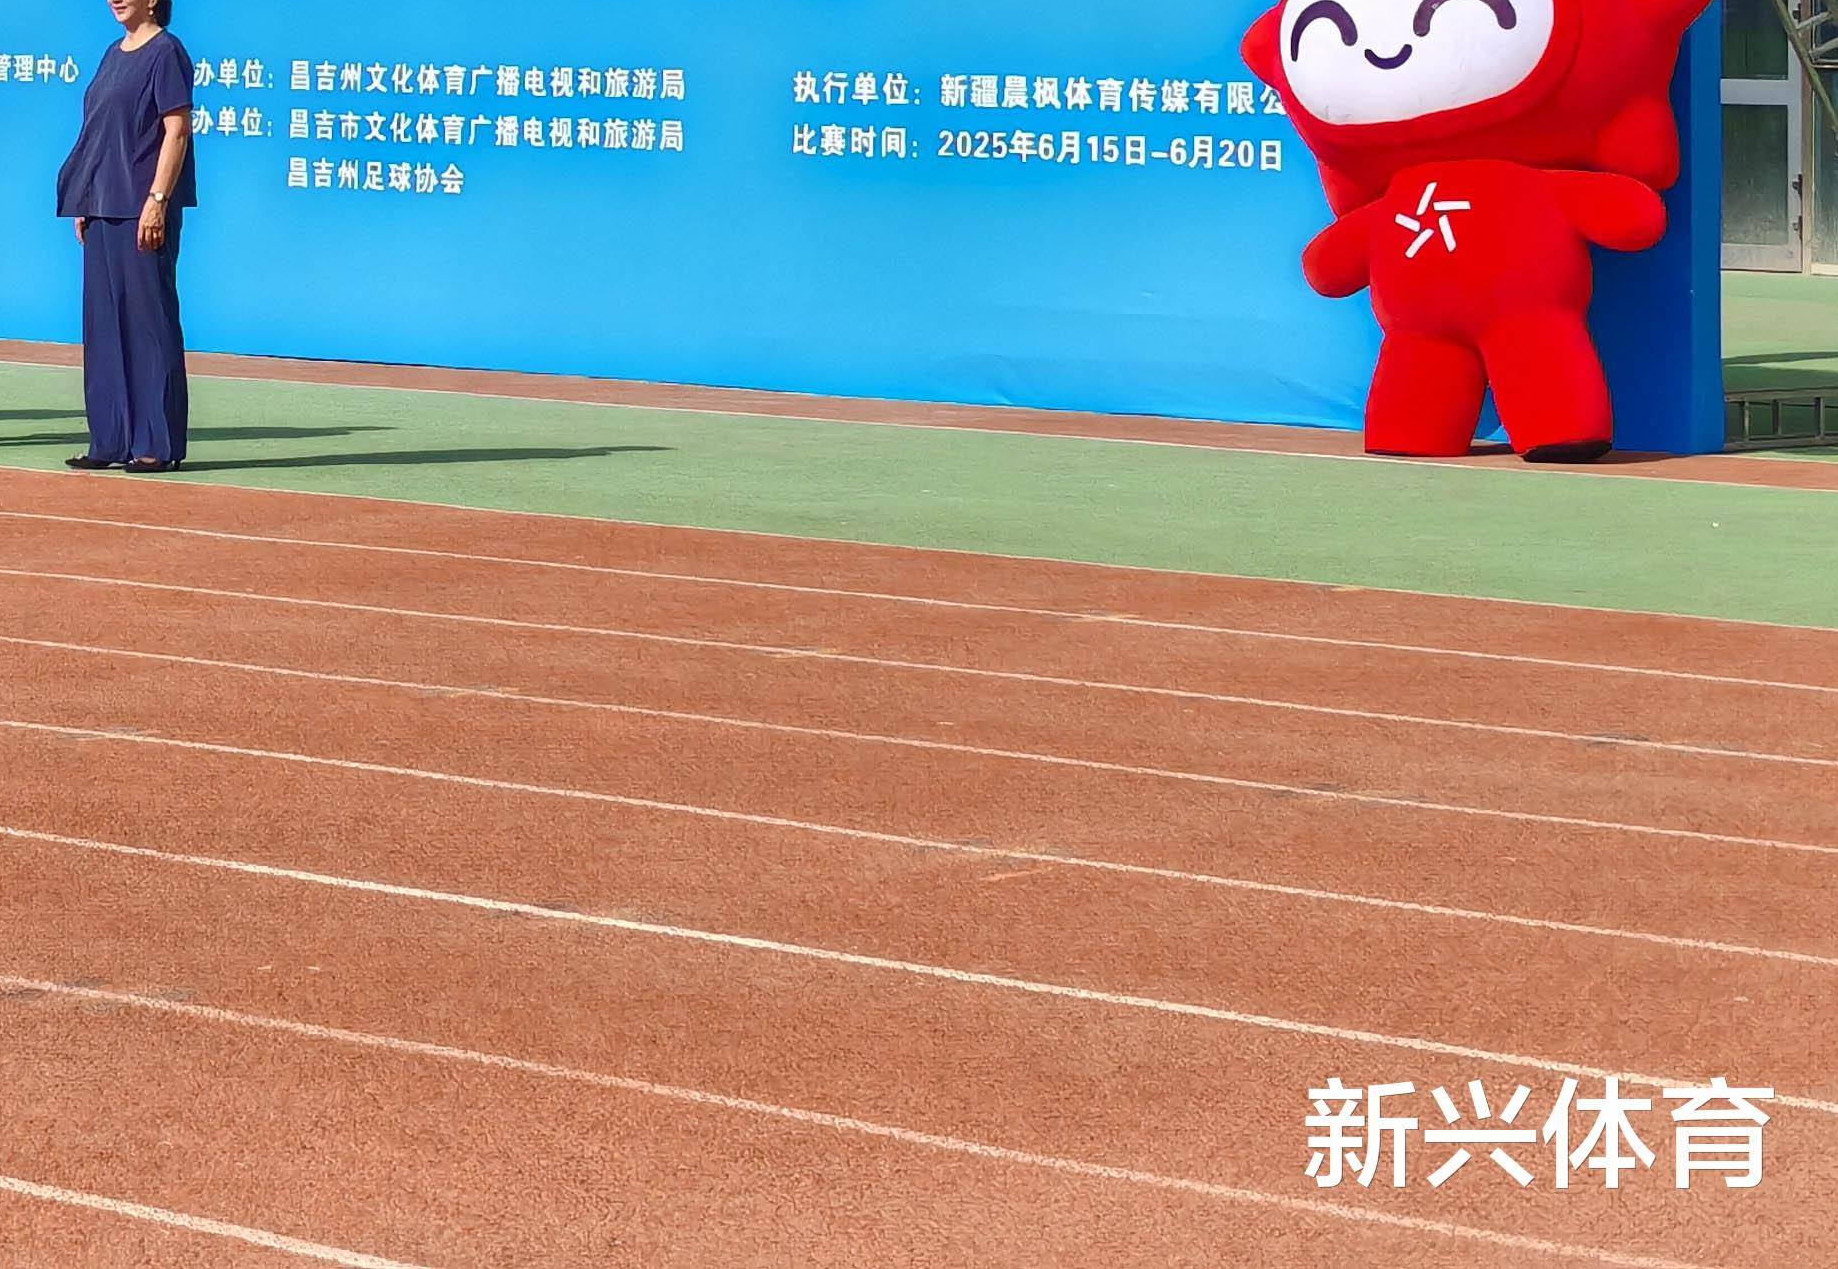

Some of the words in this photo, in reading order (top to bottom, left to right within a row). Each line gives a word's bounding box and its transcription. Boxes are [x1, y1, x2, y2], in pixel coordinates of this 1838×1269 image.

[287, 157, 465, 195] 昌吉州足球协会
